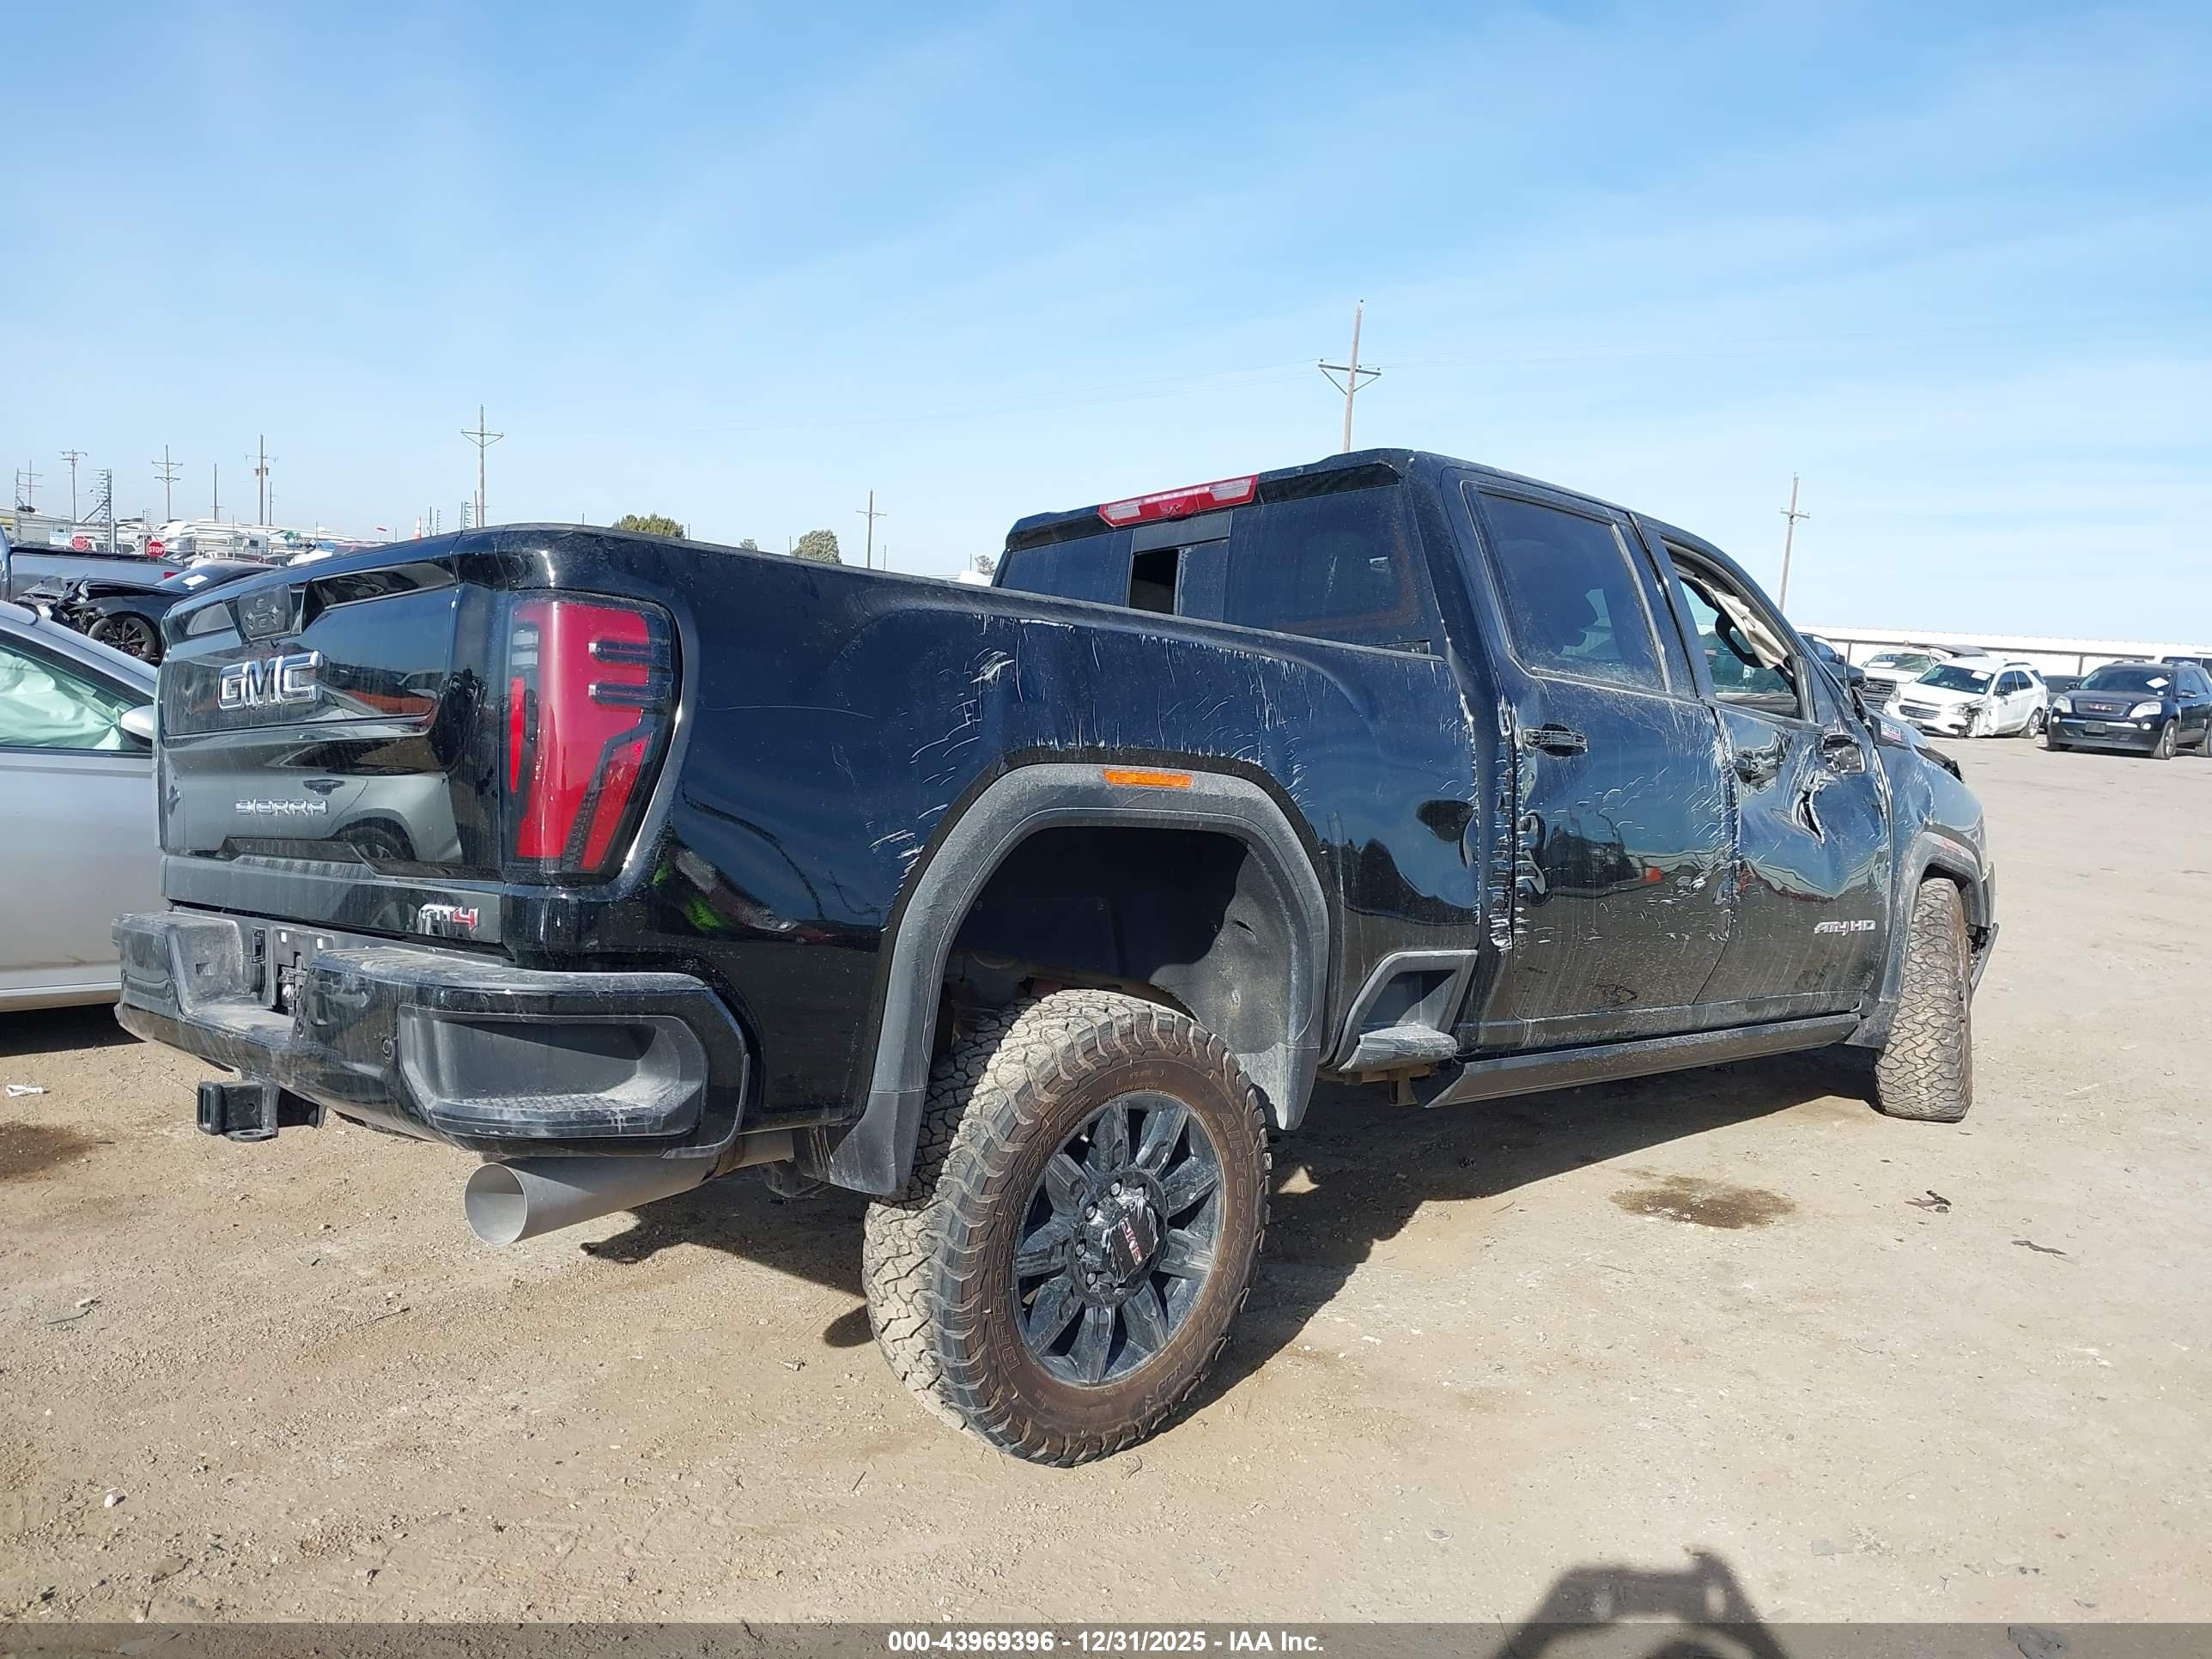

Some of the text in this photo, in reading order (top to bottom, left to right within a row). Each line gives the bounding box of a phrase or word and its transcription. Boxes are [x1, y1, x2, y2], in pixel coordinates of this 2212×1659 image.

[148, 545, 164, 554] STOP
[218, 650, 325, 711] GMC
[234, 798, 329, 817] SIERRA
[417, 903, 479, 935] AT4
[1119, 1216, 1143, 1266] GMC
